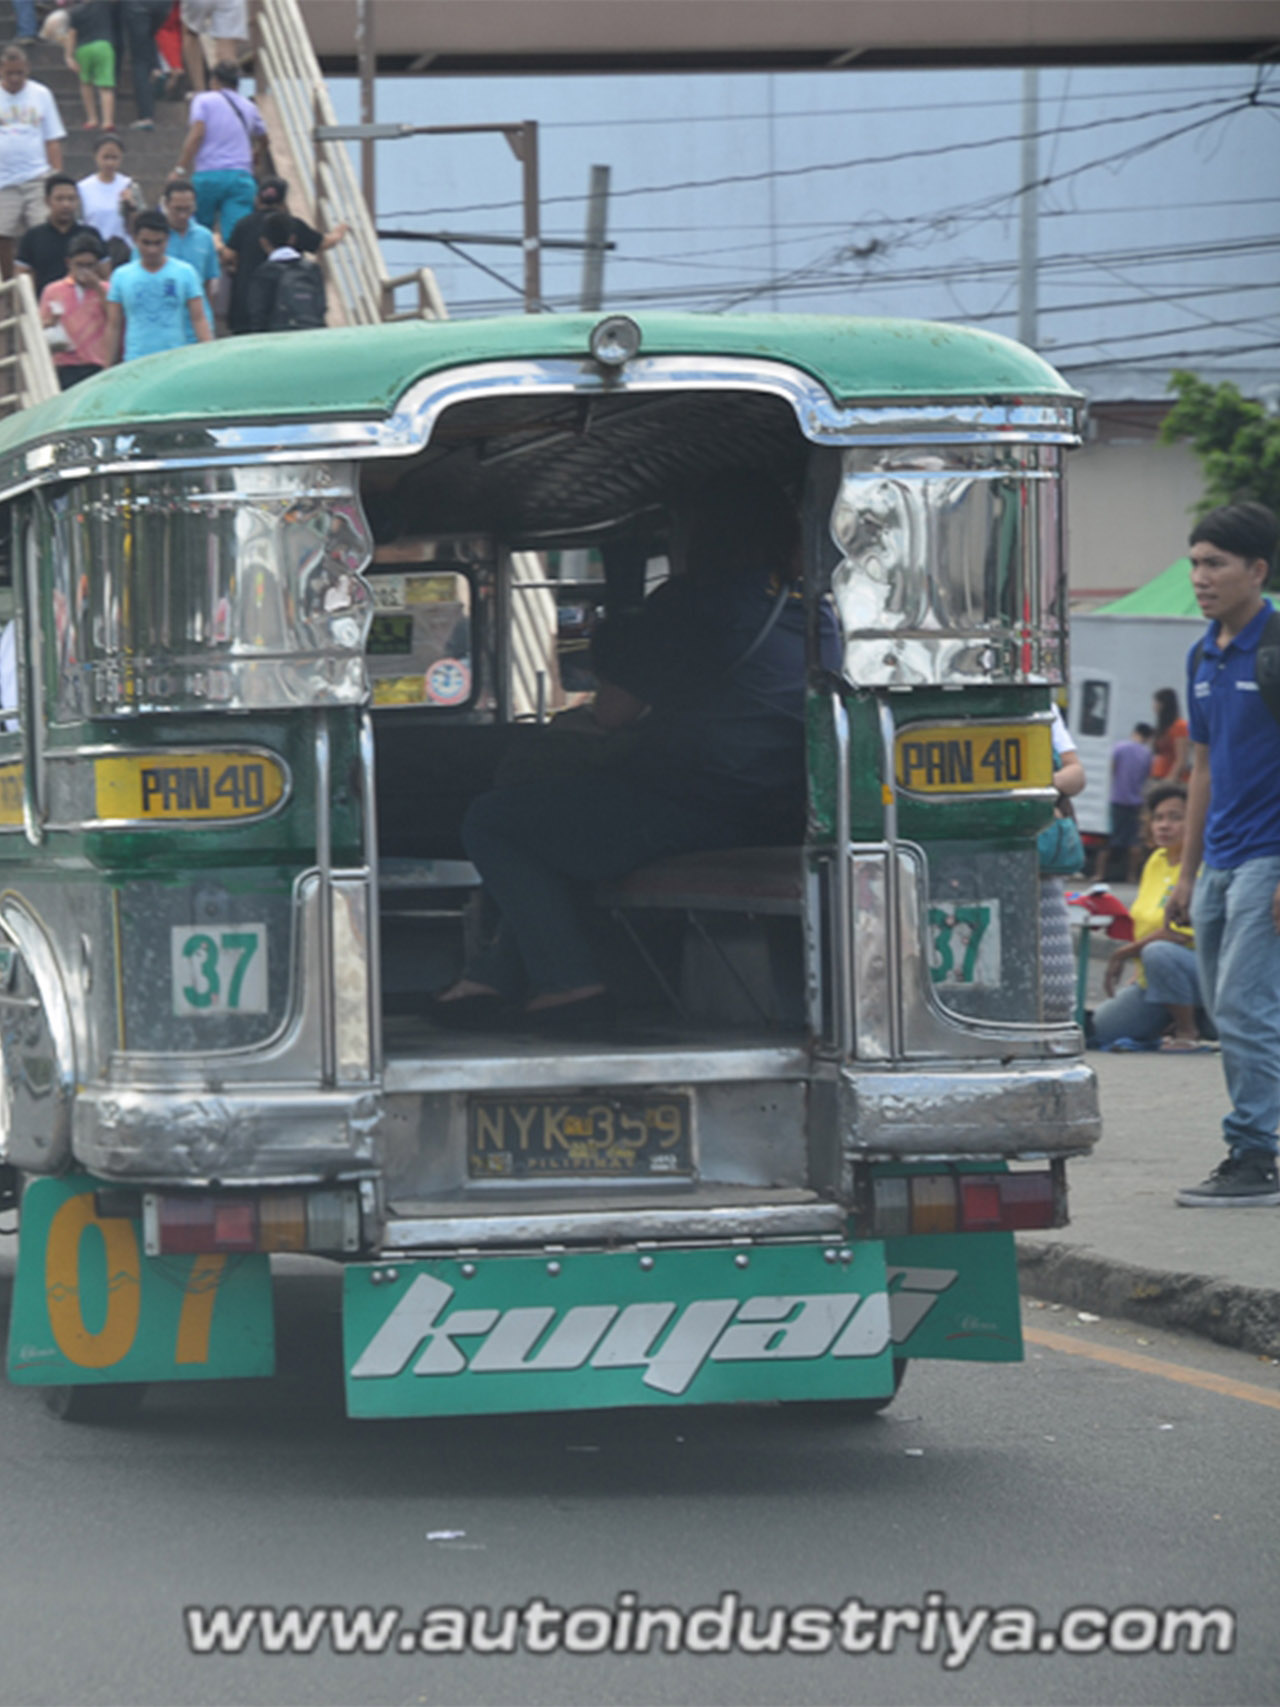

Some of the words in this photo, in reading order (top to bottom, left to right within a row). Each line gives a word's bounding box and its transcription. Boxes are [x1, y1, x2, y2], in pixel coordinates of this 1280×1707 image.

[901, 740, 974, 786] PAN
[980, 738, 1022, 782] 40
[140, 766, 211, 812] PAN
[214, 763, 266, 809] 40
[181, 931, 260, 1010] 37
[477, 1105, 571, 1150] NYK
[587, 1104, 683, 1149] 359
